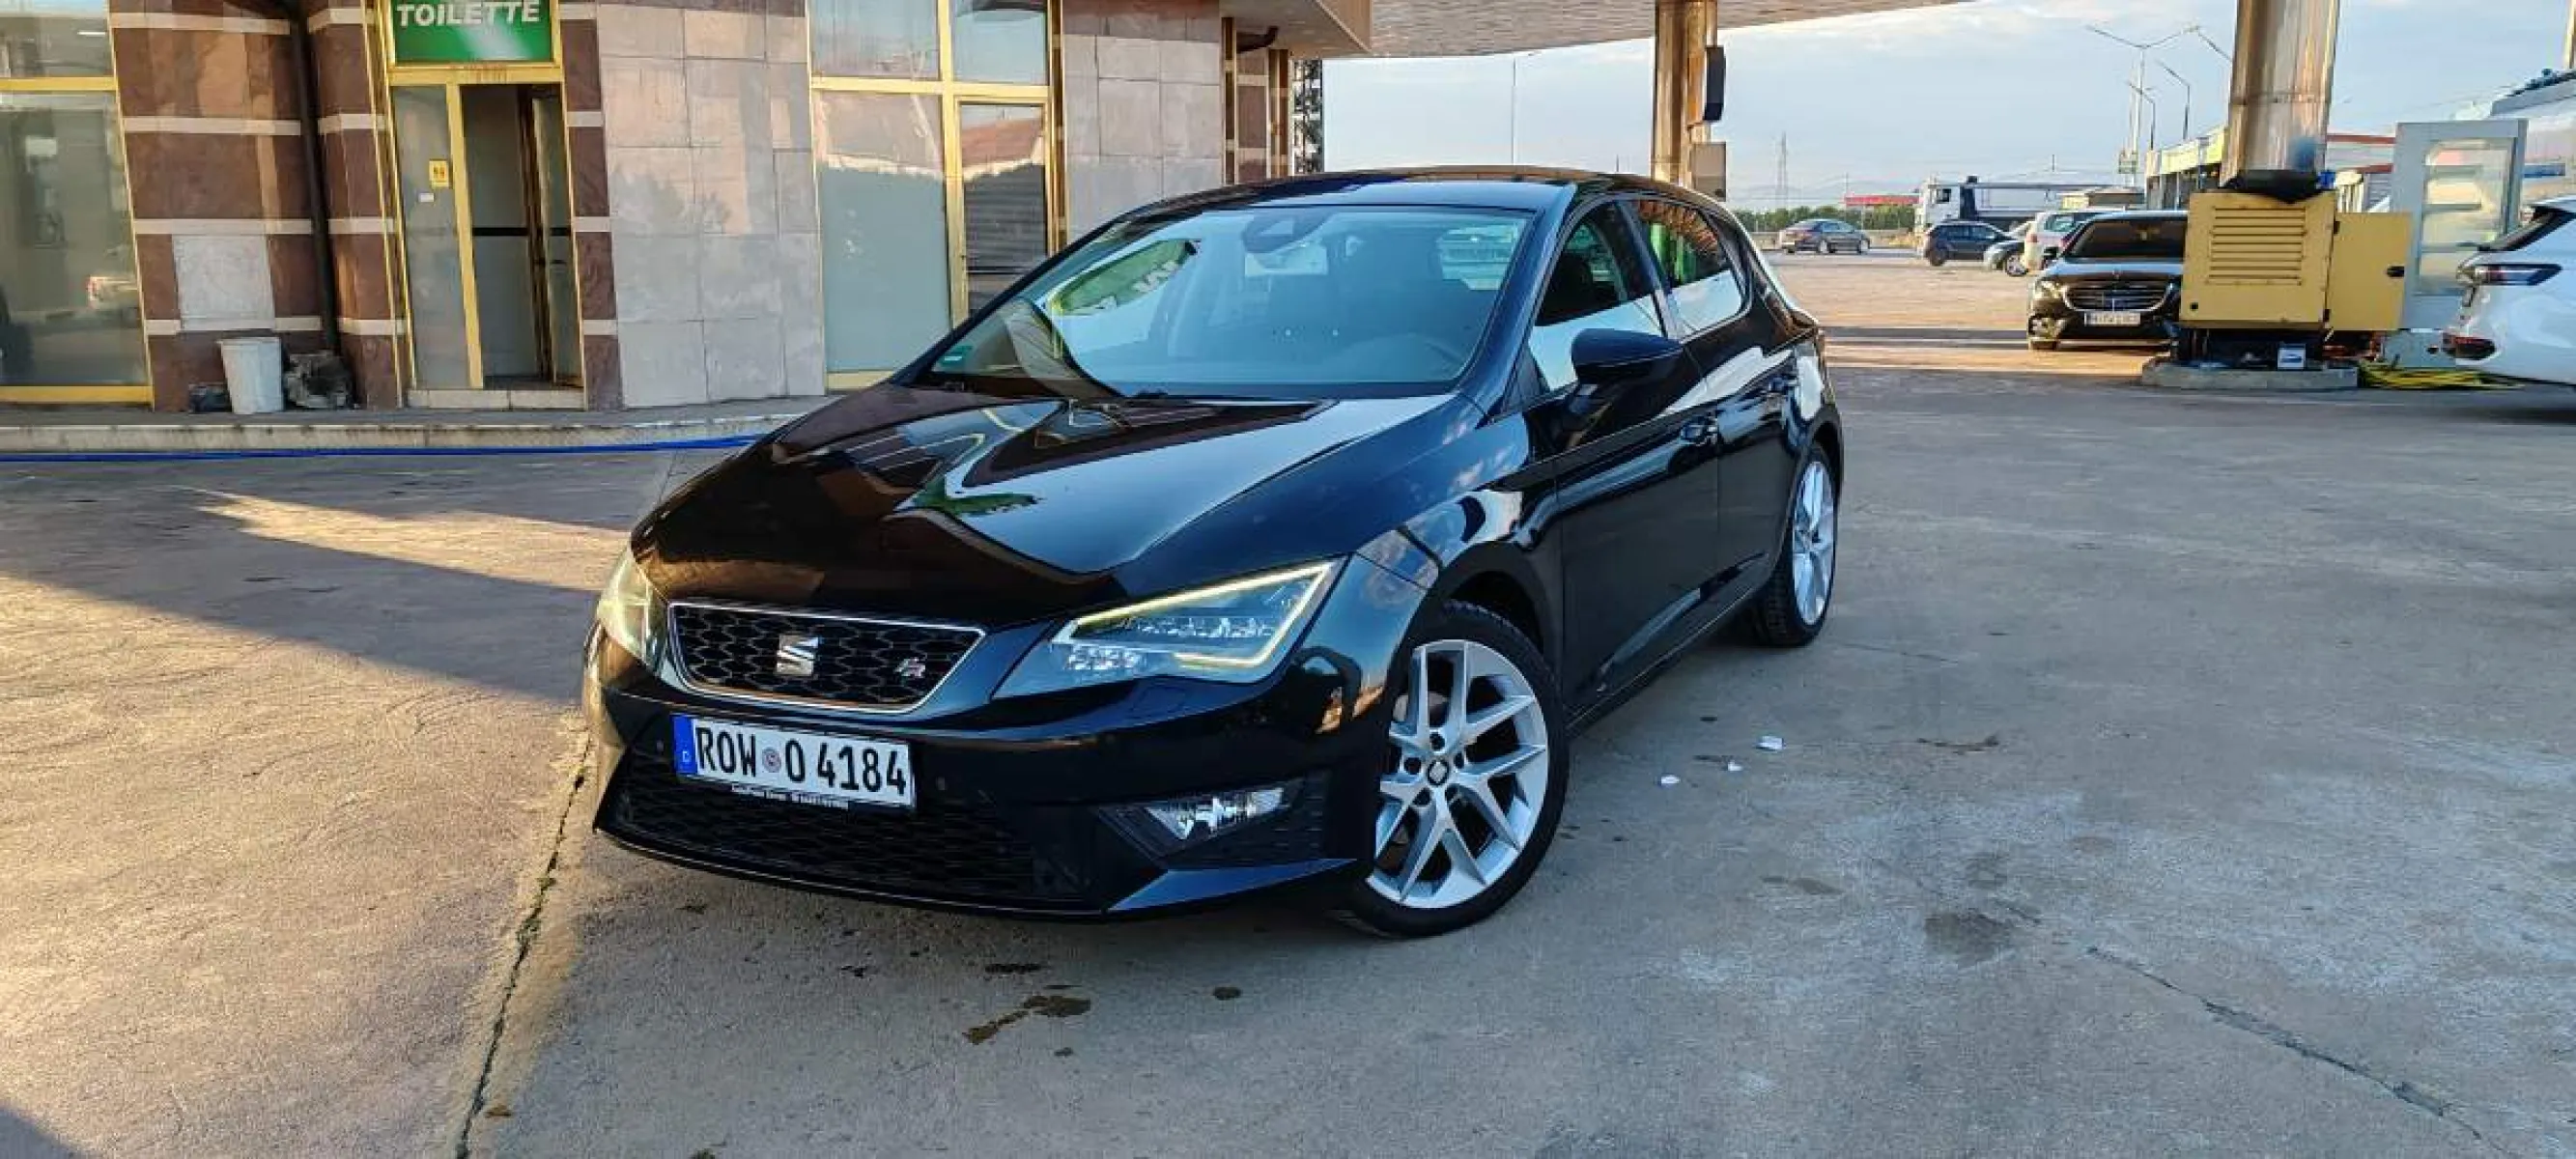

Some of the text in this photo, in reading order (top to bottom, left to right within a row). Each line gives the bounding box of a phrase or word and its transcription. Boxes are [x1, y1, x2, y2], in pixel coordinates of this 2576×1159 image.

[397, 0, 540, 27] TOILETTE
[695, 727, 756, 777] ROW
[817, 742, 906, 795] 4184
